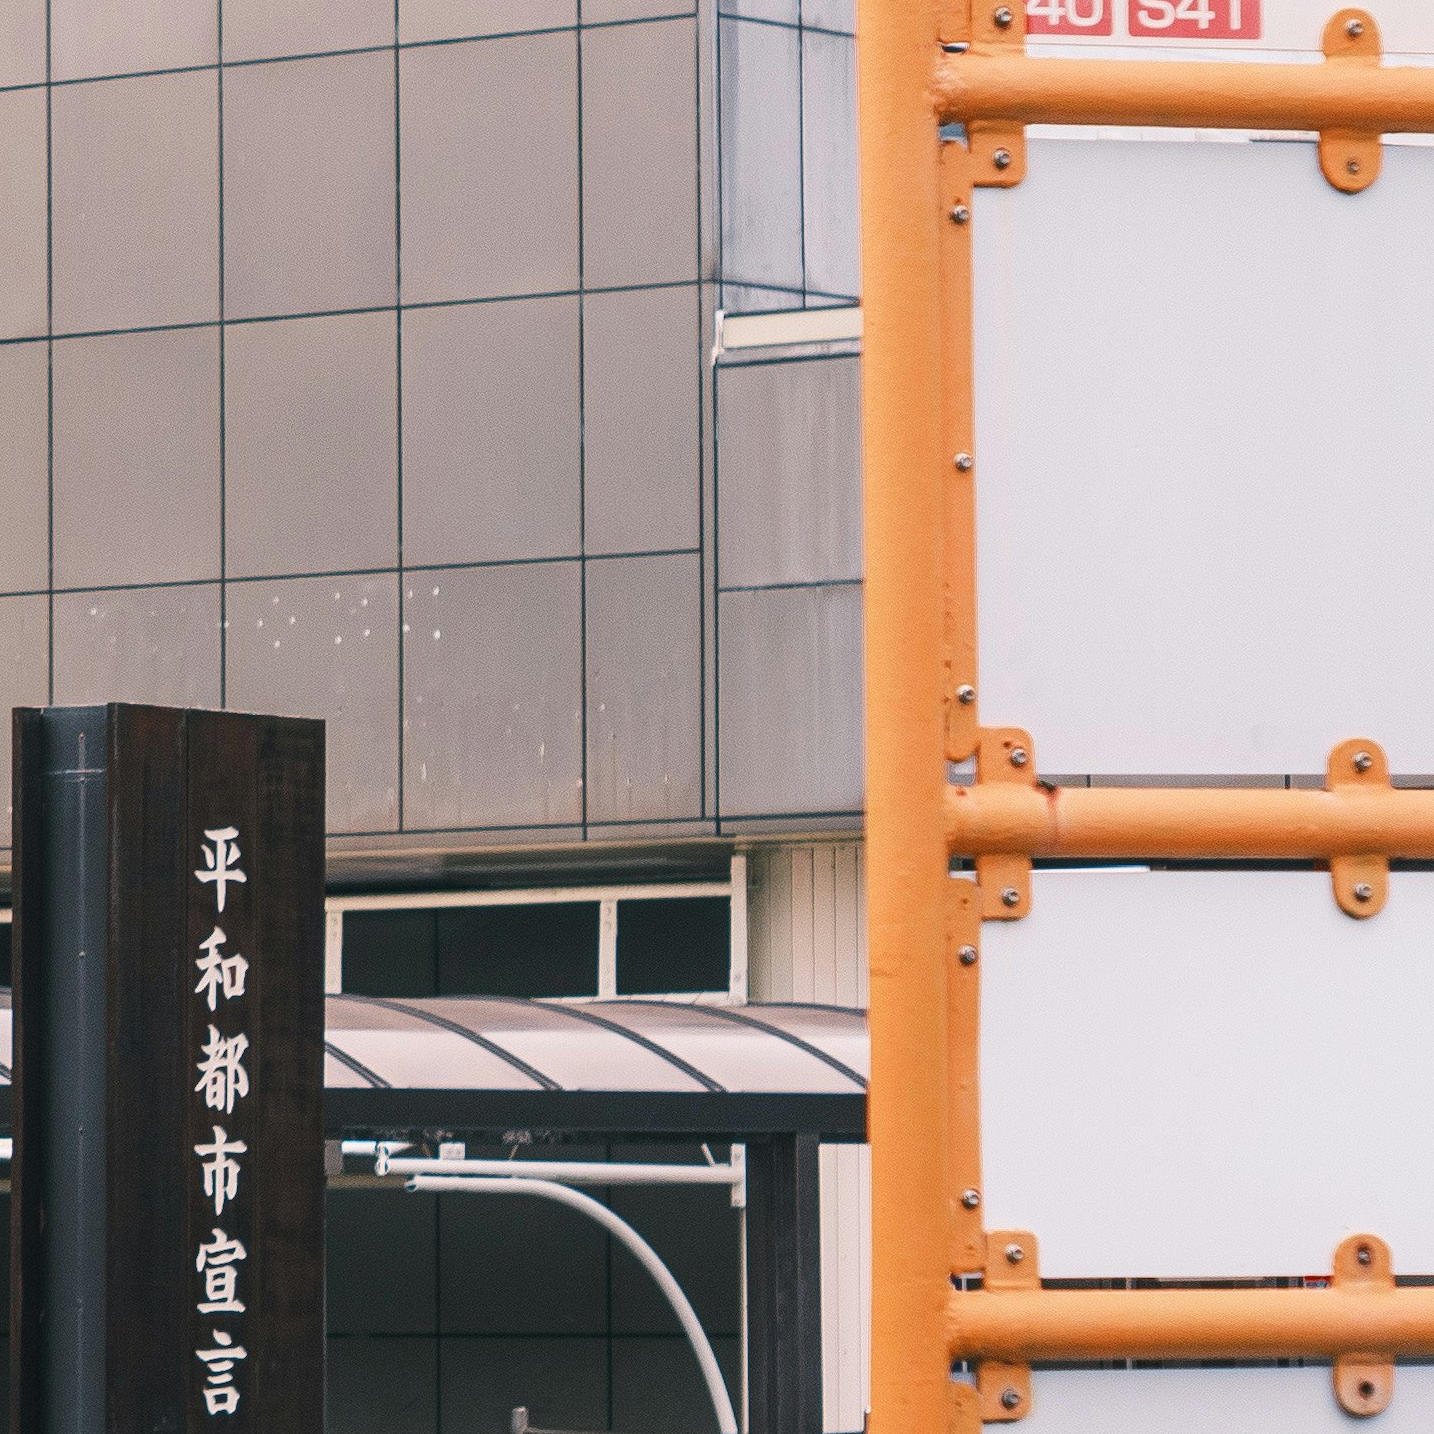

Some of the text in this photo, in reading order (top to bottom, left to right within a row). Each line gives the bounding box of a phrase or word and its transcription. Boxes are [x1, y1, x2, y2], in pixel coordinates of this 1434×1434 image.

[193, 826, 249, 1416] 平和都市宣言
